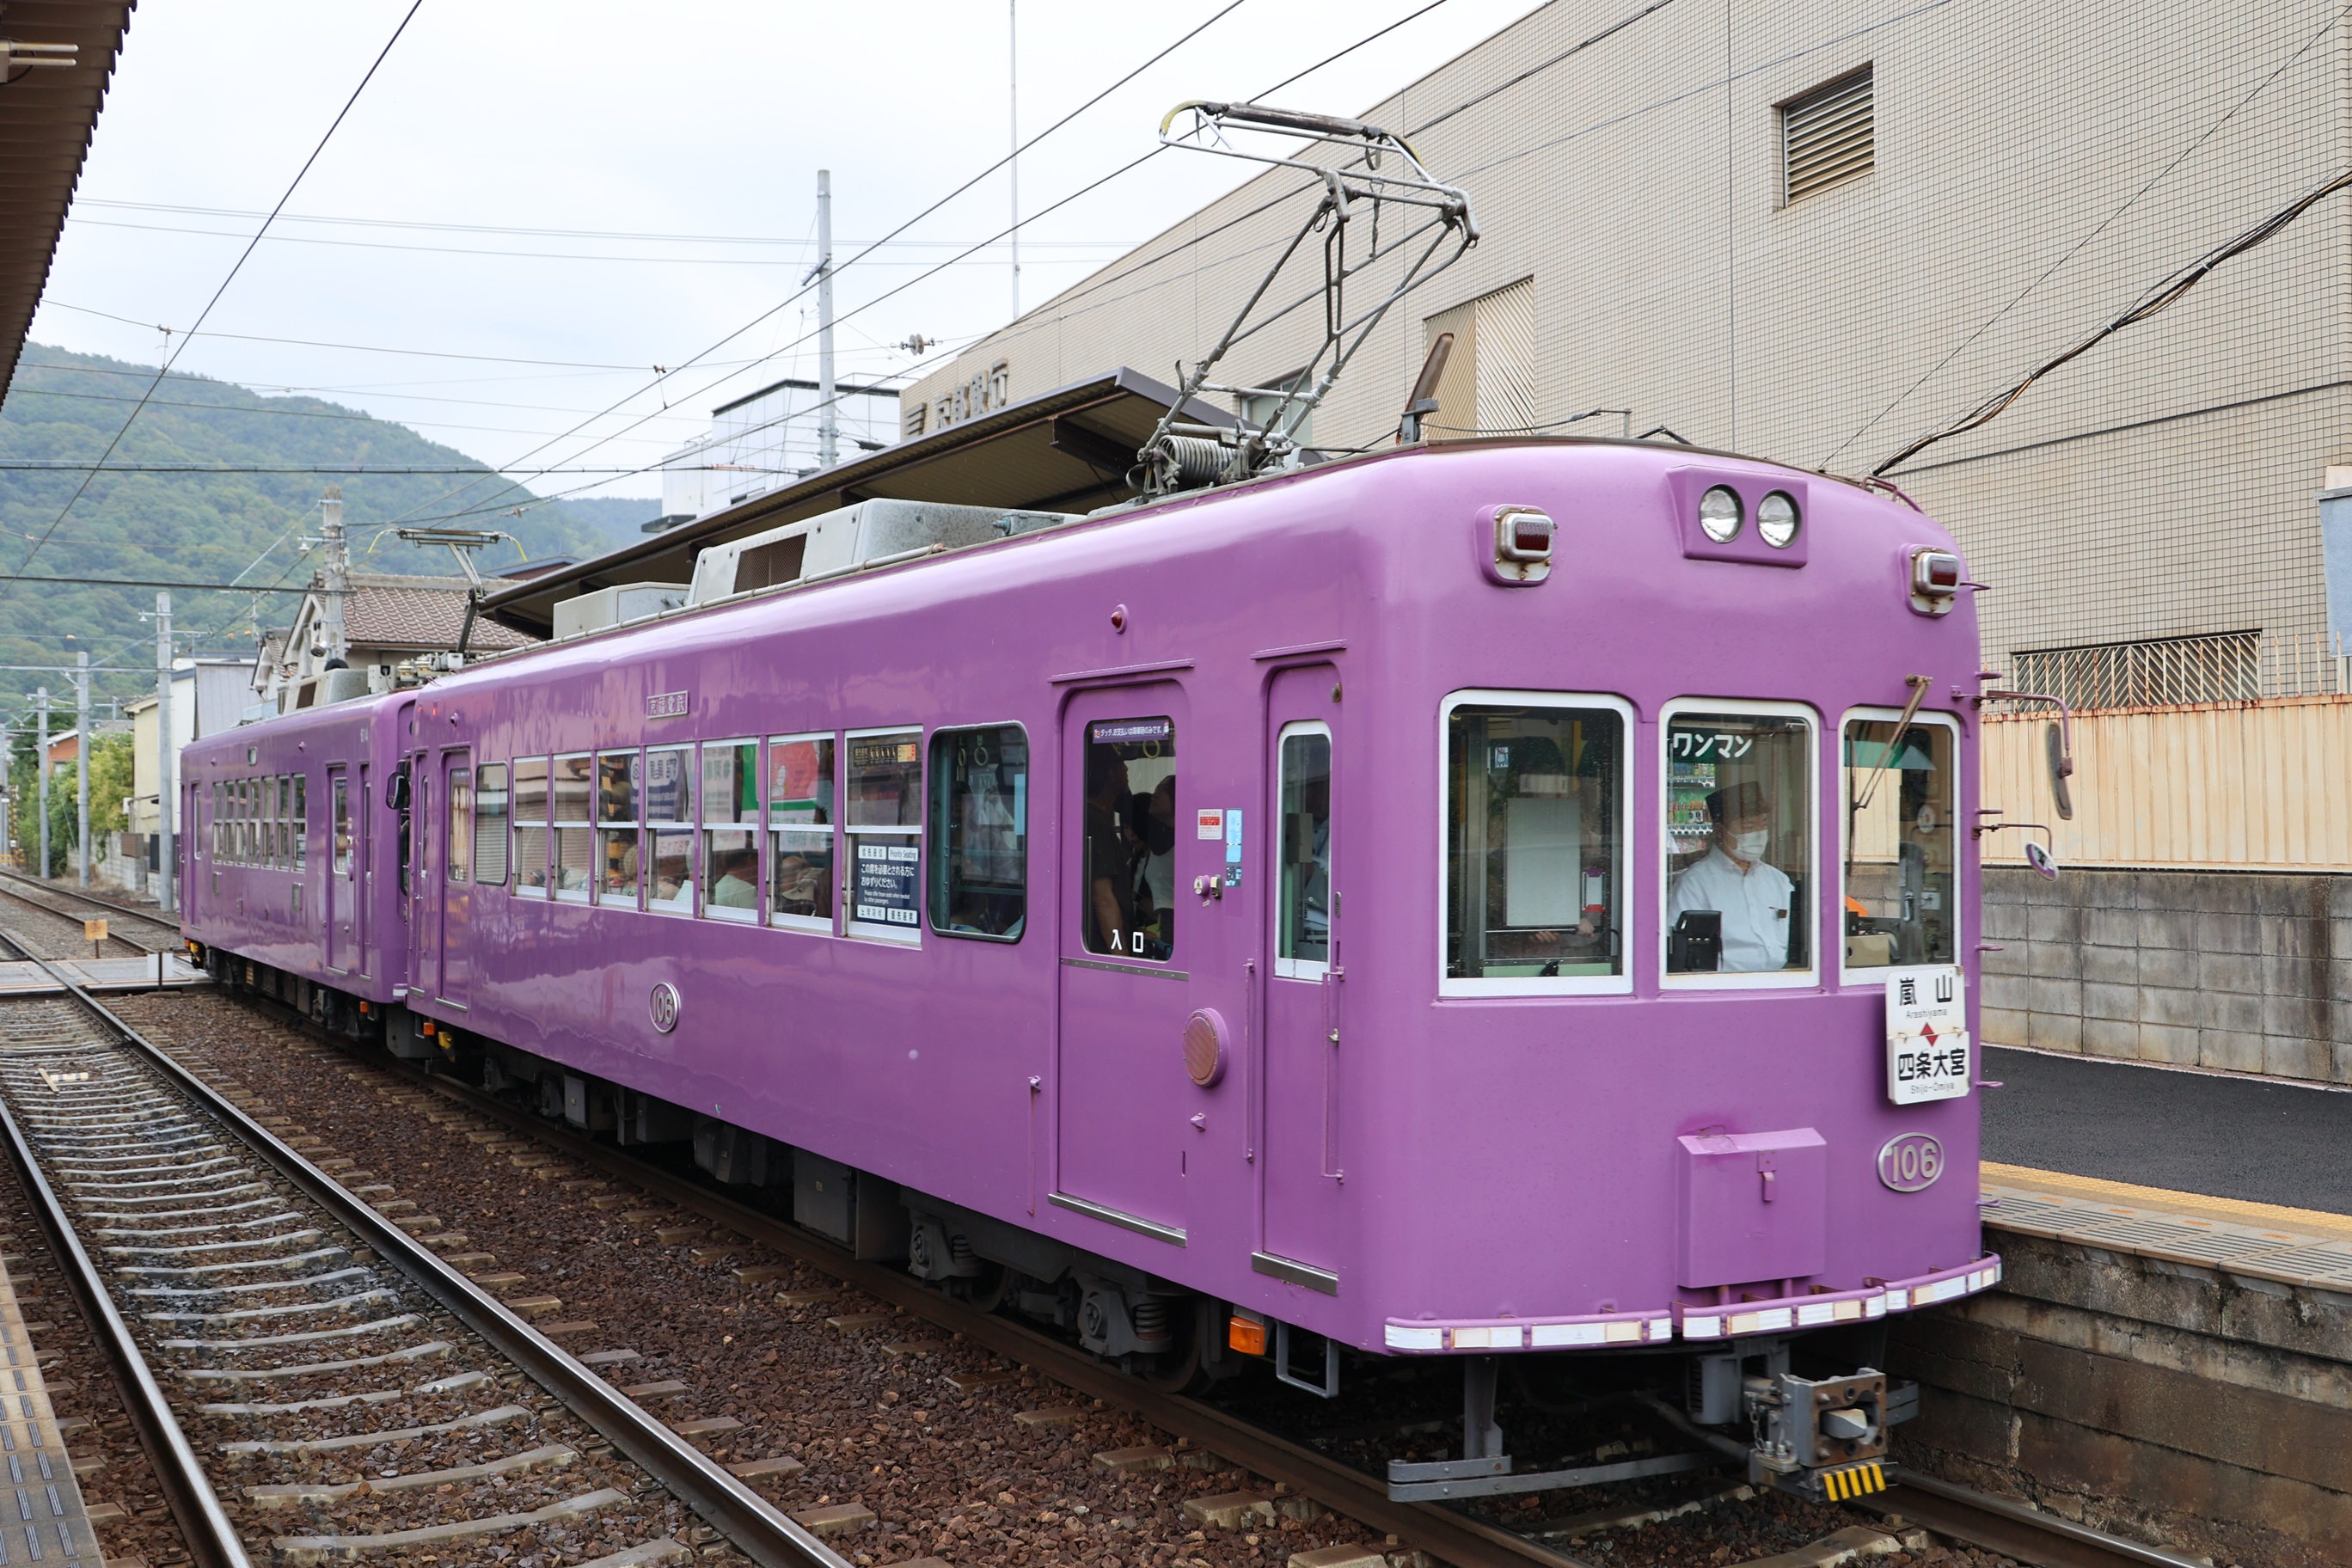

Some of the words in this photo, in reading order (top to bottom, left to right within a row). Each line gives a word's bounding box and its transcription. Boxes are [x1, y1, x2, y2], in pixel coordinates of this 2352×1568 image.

[934, 357, 1008, 430] 京都銀行
[1672, 732, 1753, 758] ワンマン
[1111, 929, 1144, 953] 入口
[1899, 974, 1952, 1006] 嵐山
[653, 990, 673, 1025] 106
[1905, 1009, 1948, 1020] Arashiyama
[1898, 1048, 1965, 1081] 四条大宮
[1893, 1142, 1938, 1183] 106
